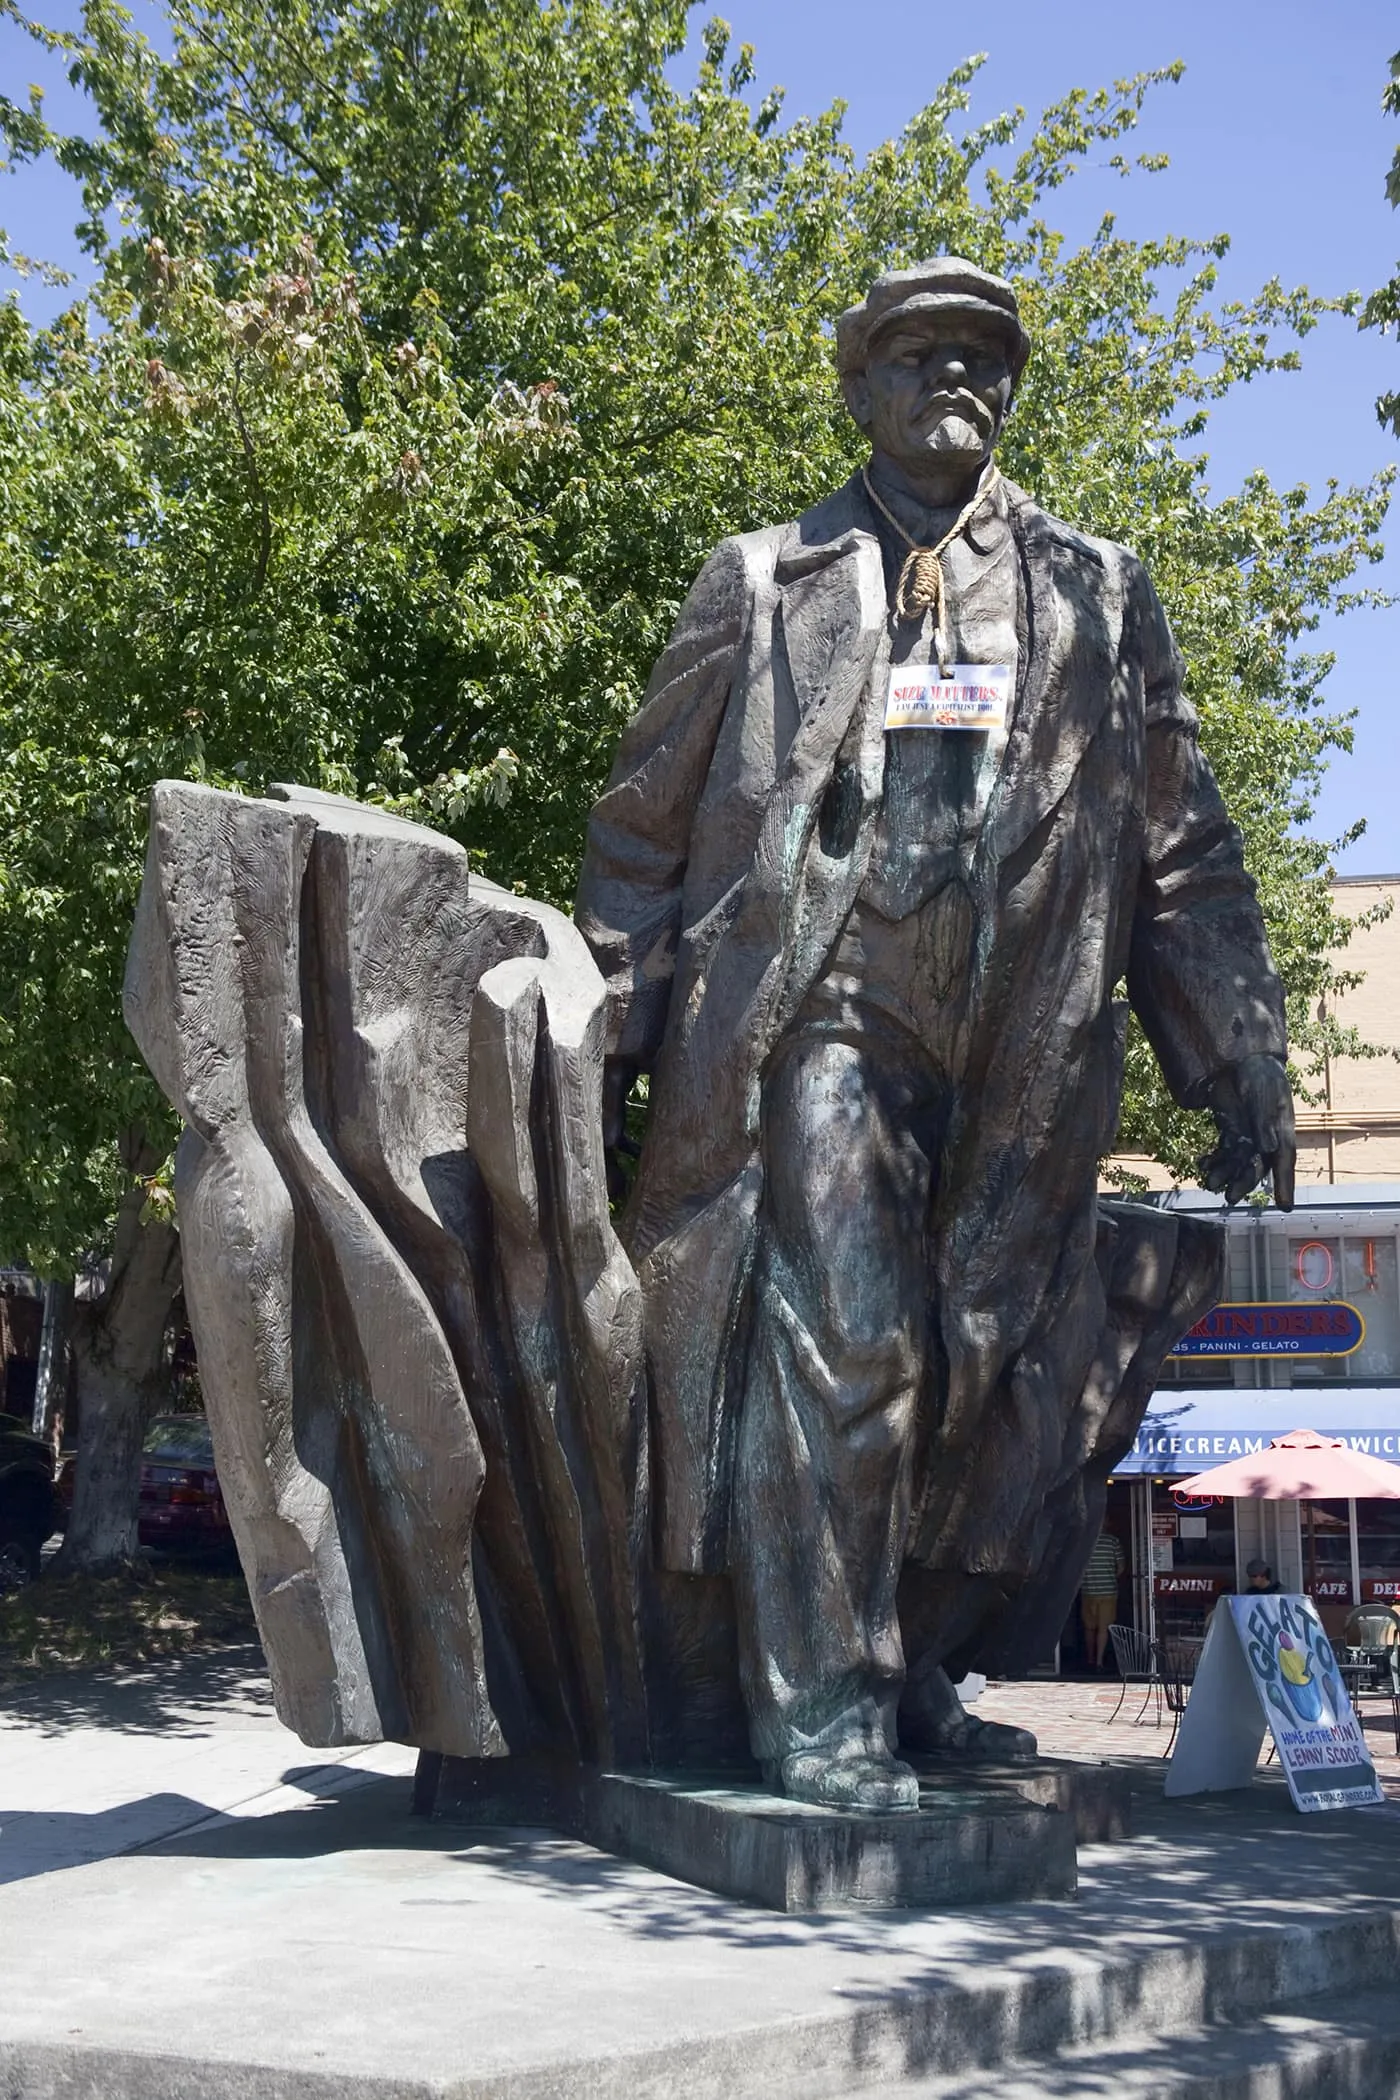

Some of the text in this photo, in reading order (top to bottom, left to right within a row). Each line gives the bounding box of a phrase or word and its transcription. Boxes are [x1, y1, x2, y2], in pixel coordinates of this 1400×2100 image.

[893, 686, 926, 702] SIZE
[1199, 1342, 1241, 1351] PANINI
[1252, 1341, 1300, 1350] GELATO
[1160, 1579, 1213, 1592] PANINI
[1248, 1597, 1333, 1681] GELATO
[1280, 1722, 1359, 1745] HOME OF THE MINI
[1285, 1745, 1362, 1768] LENNY SCOOP
